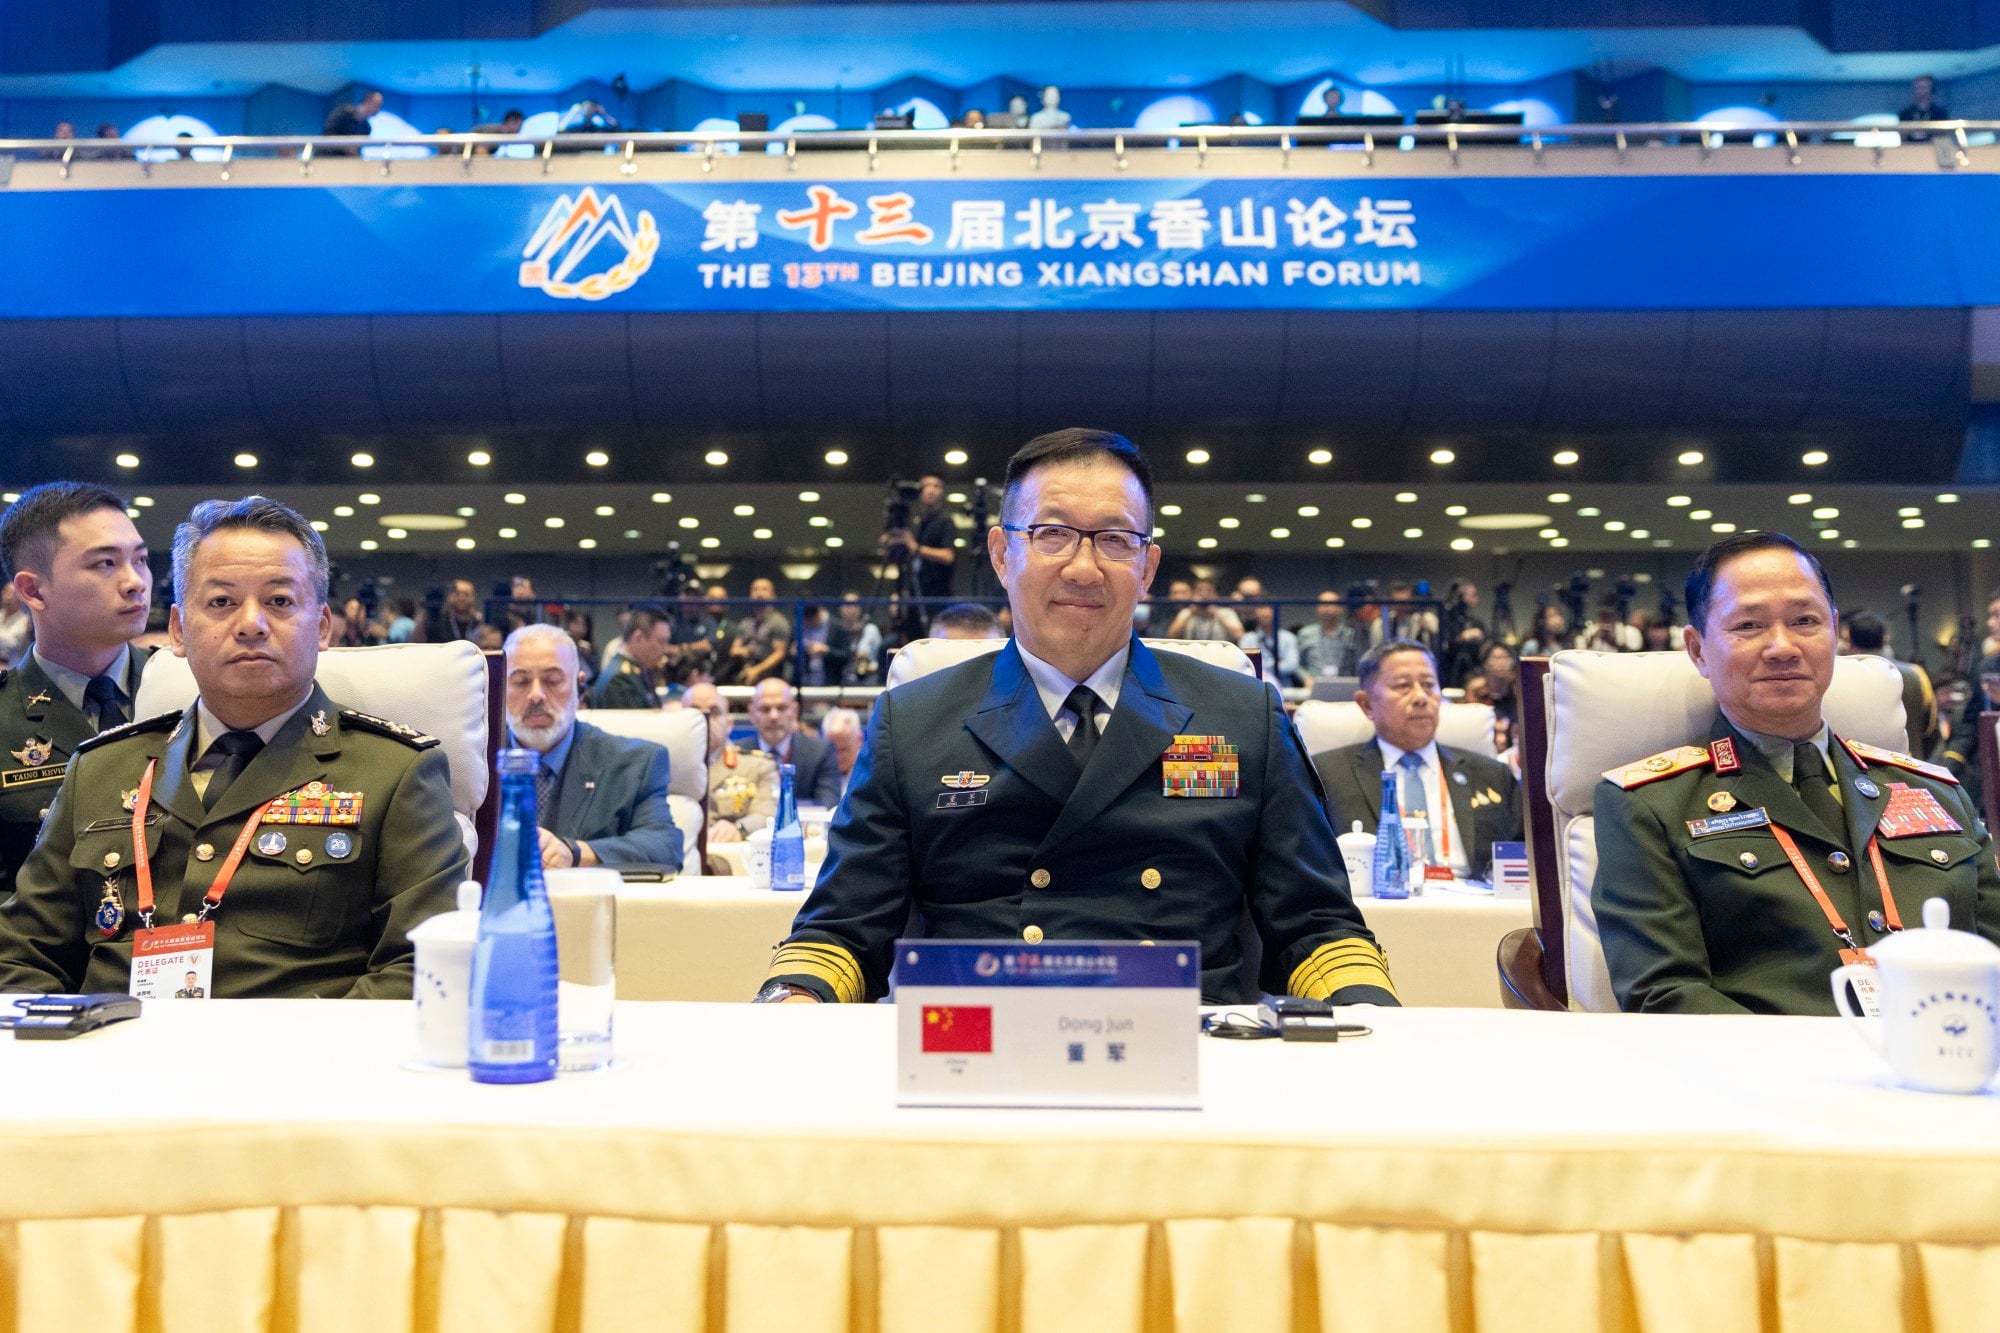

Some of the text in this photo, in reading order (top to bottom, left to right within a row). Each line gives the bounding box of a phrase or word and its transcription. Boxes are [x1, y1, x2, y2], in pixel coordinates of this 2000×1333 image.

[702, 185, 1418, 251] 第十三届北京香山论坛
[698, 260, 1422, 289] THE 13TH BEIJING XIANGSHAN FORUM
[13, 771, 38, 781] TAING
[138, 956, 184, 968] DELEGATE
